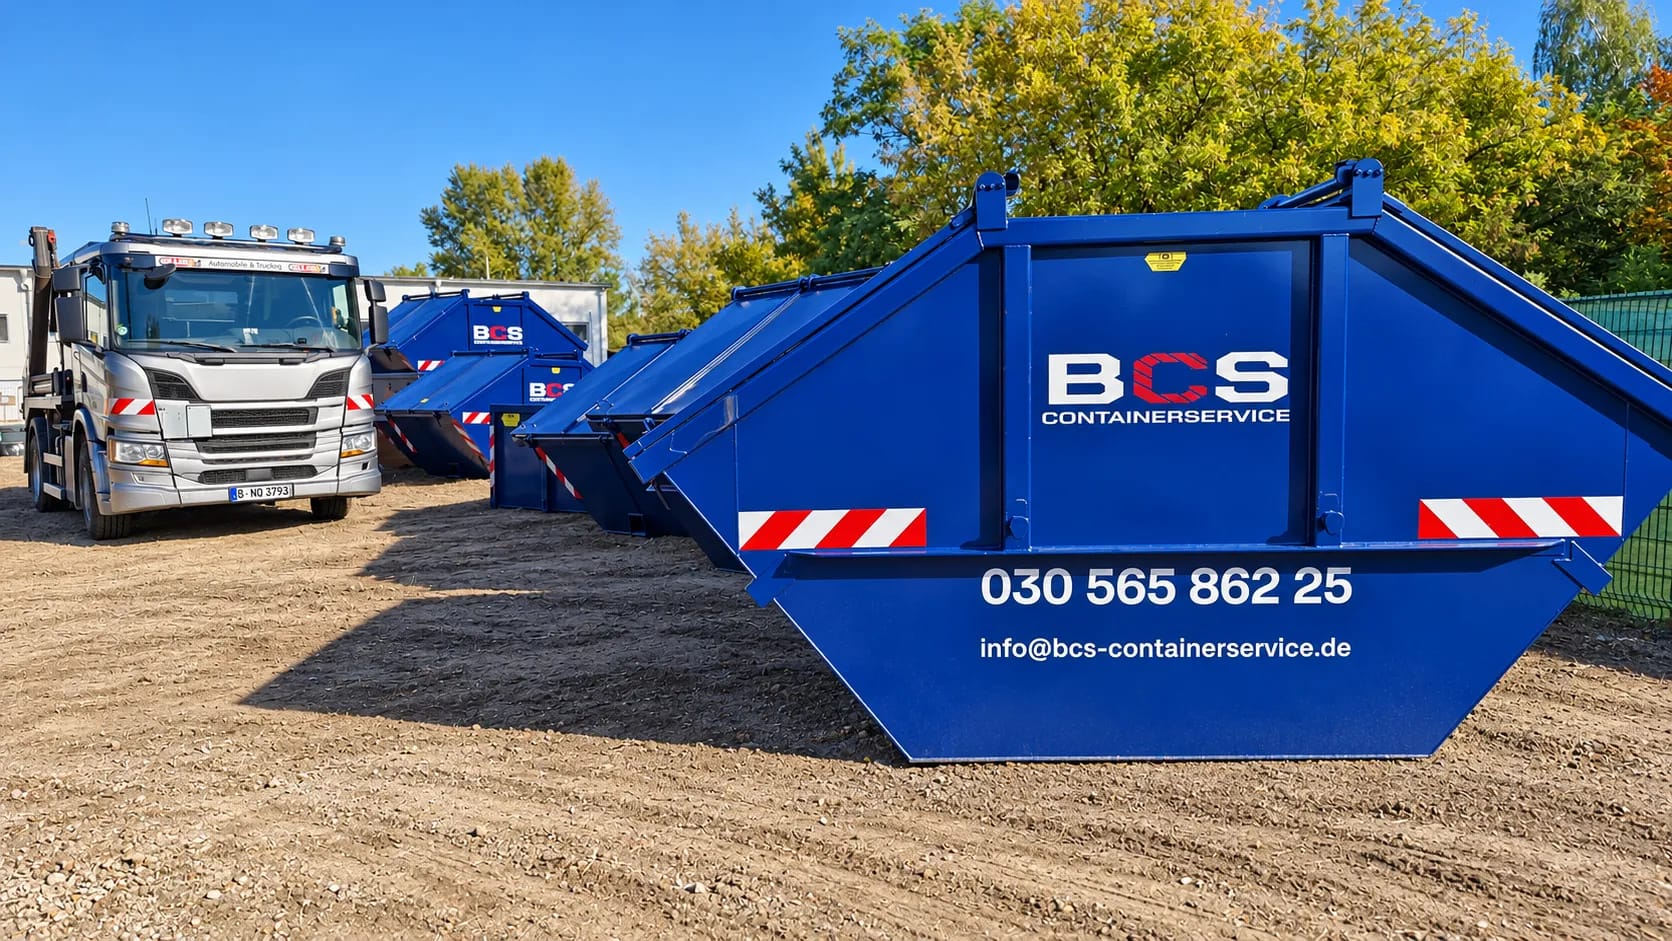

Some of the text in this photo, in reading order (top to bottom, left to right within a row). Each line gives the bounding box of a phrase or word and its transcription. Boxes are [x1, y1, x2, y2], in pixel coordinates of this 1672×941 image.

[473, 325, 523, 340] BCS
[1048, 351, 1289, 405] BCS
[1041, 409, 1291, 425] CONTAINERSERVICE
[265, 486, 289, 497] 3793
[981, 567, 1353, 606] 030 565 862 25
[980, 637, 1351, 661] info@bcs-containerservice.de
